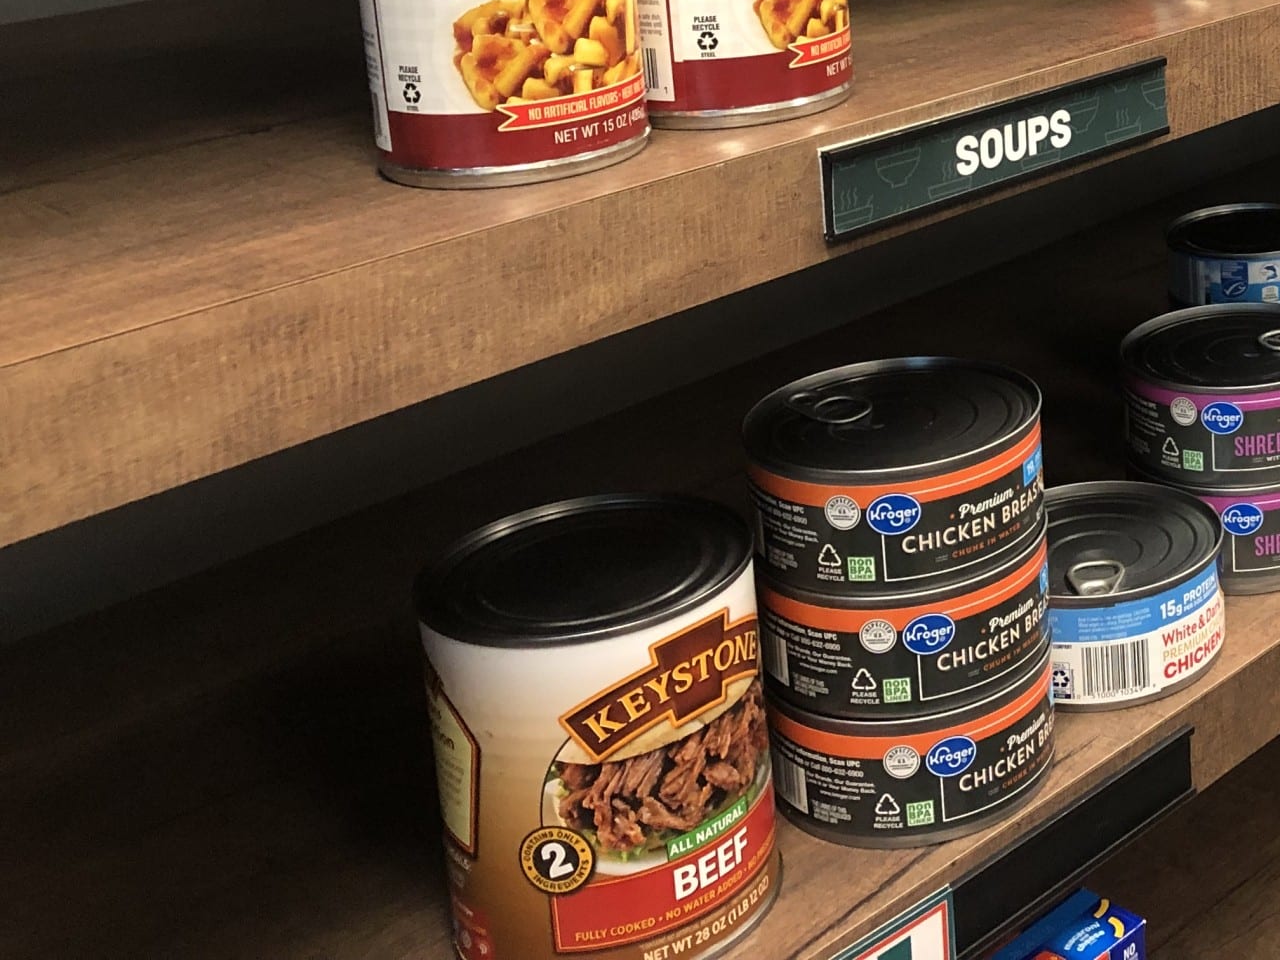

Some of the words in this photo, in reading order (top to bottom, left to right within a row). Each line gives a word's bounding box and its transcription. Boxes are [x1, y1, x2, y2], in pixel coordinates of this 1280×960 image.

[692, 23, 720, 31] RECYCLE
[693, 15, 717, 23] PLEASE
[826, 63, 840, 77] NET
[528, 107, 542, 121] NO
[544, 100, 588, 119] ARTIFICIAL
[554, 127, 578, 144] NET
[581, 122, 600, 139] WT
[602, 118, 614, 133] 15
[616, 113, 628, 128] OZ
[955, 109, 1072, 176] SOUPS
[1203, 408, 1241, 429] Kroger
[958, 486, 1014, 520] Premium
[869, 503, 919, 528] Kroger
[1224, 510, 1261, 529] Kroger
[901, 511, 996, 554] CHICKEN
[951, 544, 985, 559] CHUNK
[999, 522, 1021, 543] WATER
[817, 566, 843, 576] PLEASE
[849, 557, 873, 566] non
[849, 565, 873, 575] BPA
[816, 574, 845, 582] RECYCLE
[1160, 598, 1183, 620] 15g
[1183, 572, 1216, 604] PROTEIN
[988, 597, 1034, 633] Premium
[823, 632, 838, 641] UPC
[905, 623, 952, 647] Kroger
[1162, 621, 1197, 647] White
[937, 627, 1021, 672] CHICKEN
[1163, 632, 1208, 662] PREMIUM
[1163, 630, 1222, 679] CHICKEN
[982, 653, 1011, 672] CHUNK
[581, 628, 756, 744] KEYSTONE
[851, 690, 877, 698] PLEASE
[884, 678, 910, 687] non
[884, 687, 909, 696] BPA
[850, 697, 880, 705] RECYCLE
[1006, 713, 1046, 752] Premium
[829, 757, 845, 767] Scan
[846, 759, 861, 769] UPC
[929, 745, 973, 769] Kroger
[958, 745, 1035, 792] CHICKEN
[908, 802, 932, 811] non
[908, 810, 932, 819] BPA
[874, 815, 900, 823] PLEASE
[669, 840, 694, 857] ALL
[695, 806, 745, 844] NATURAL
[523, 828, 553, 862] CONTAINS
[555, 829, 581, 846] ONLY
[540, 842, 573, 879] 2
[673, 826, 748, 901] BEEF
[533, 858, 590, 893] INGREDIENTS
[575, 927, 607, 942] FULLY
[610, 916, 655, 936] COOKED
[665, 906, 681, 920] NO
[684, 892, 716, 915] WATER
[717, 869, 744, 897] ADDED
[643, 941, 671, 960] NET
[672, 935, 693, 952] WT
[695, 926, 710, 944] 28
[712, 916, 727, 935] OZ
[738, 901, 749, 918] LB
